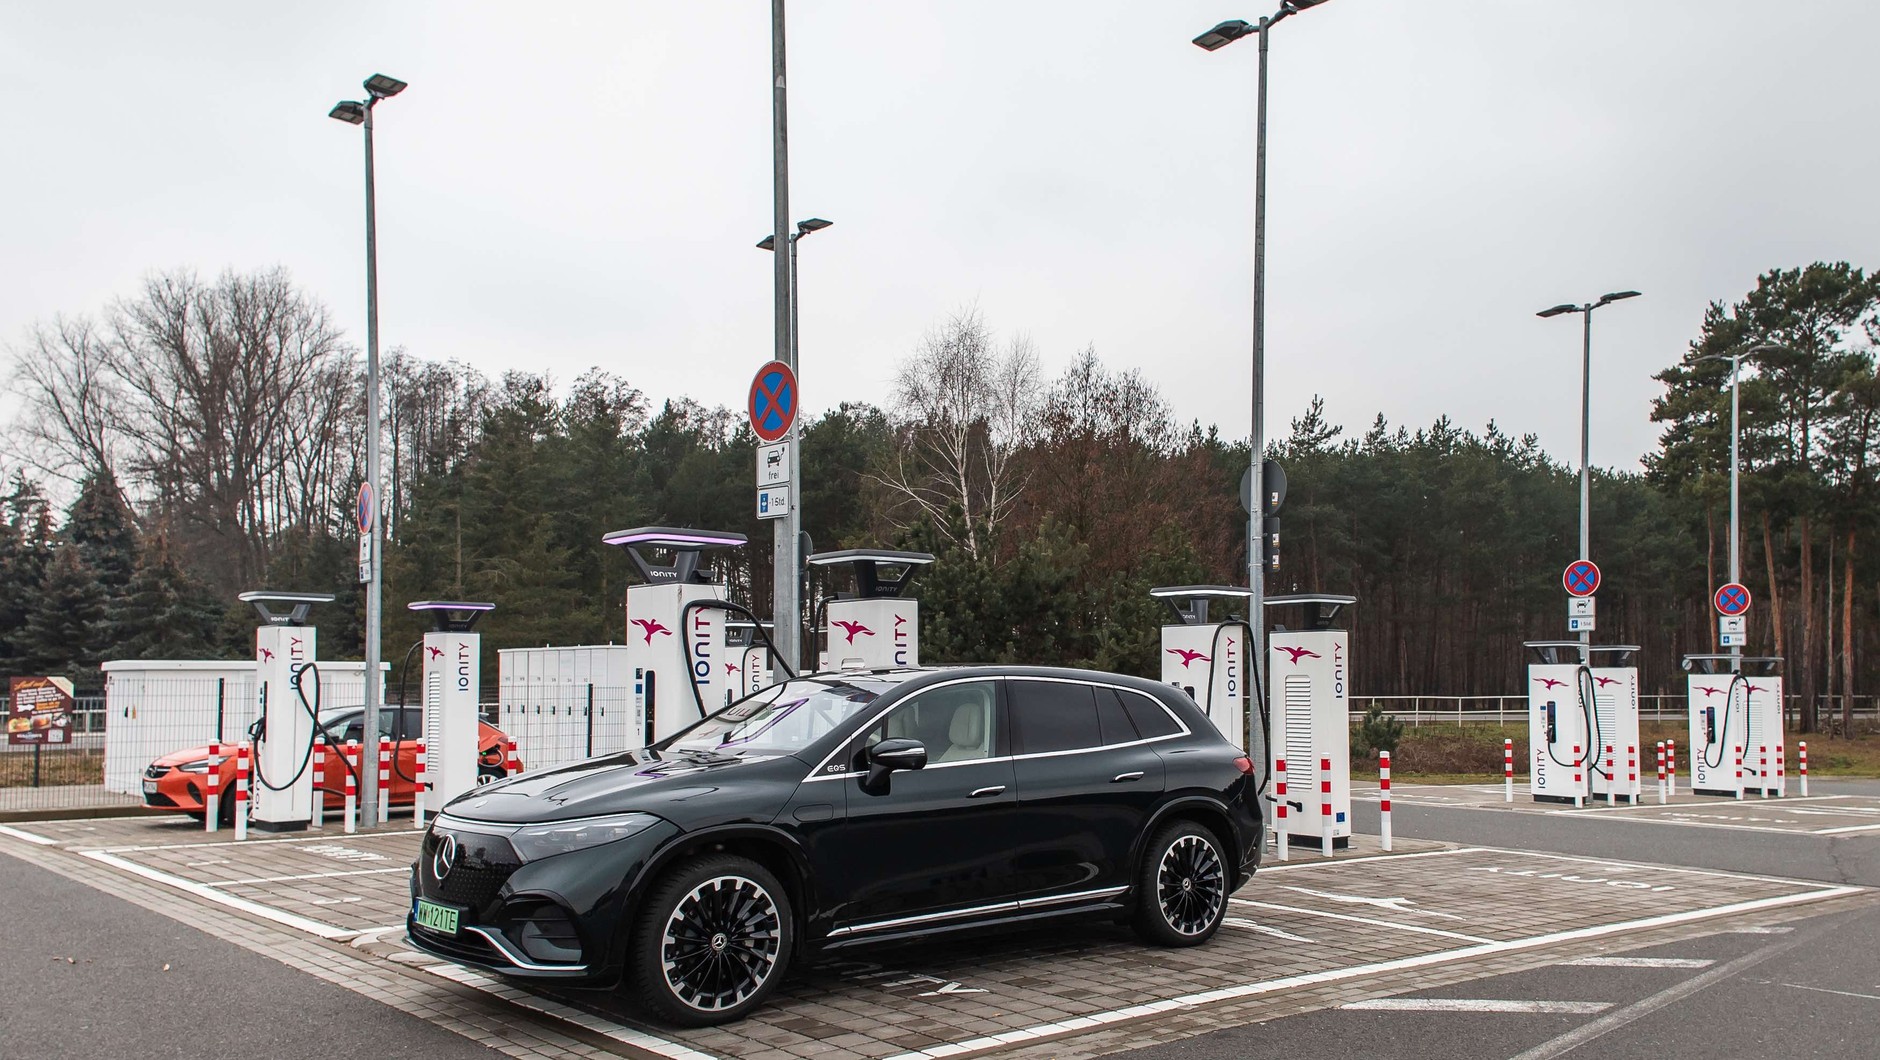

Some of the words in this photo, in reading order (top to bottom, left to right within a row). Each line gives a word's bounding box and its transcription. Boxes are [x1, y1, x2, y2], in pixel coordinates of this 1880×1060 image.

[769, 470, 779, 480] frei
[895, 614, 908, 666] NITY
[459, 642, 469, 691] IONITY
[752, 655, 760, 692] ONITY
[1227, 637, 1236, 697] IONITY
[1335, 642, 1343, 698] IONITY
[827, 764, 846, 772] EQS
[1537, 749, 1546, 789] IONITY
[1697, 748, 1706, 784] IONITY
[430, 906, 456, 931] 121TE
